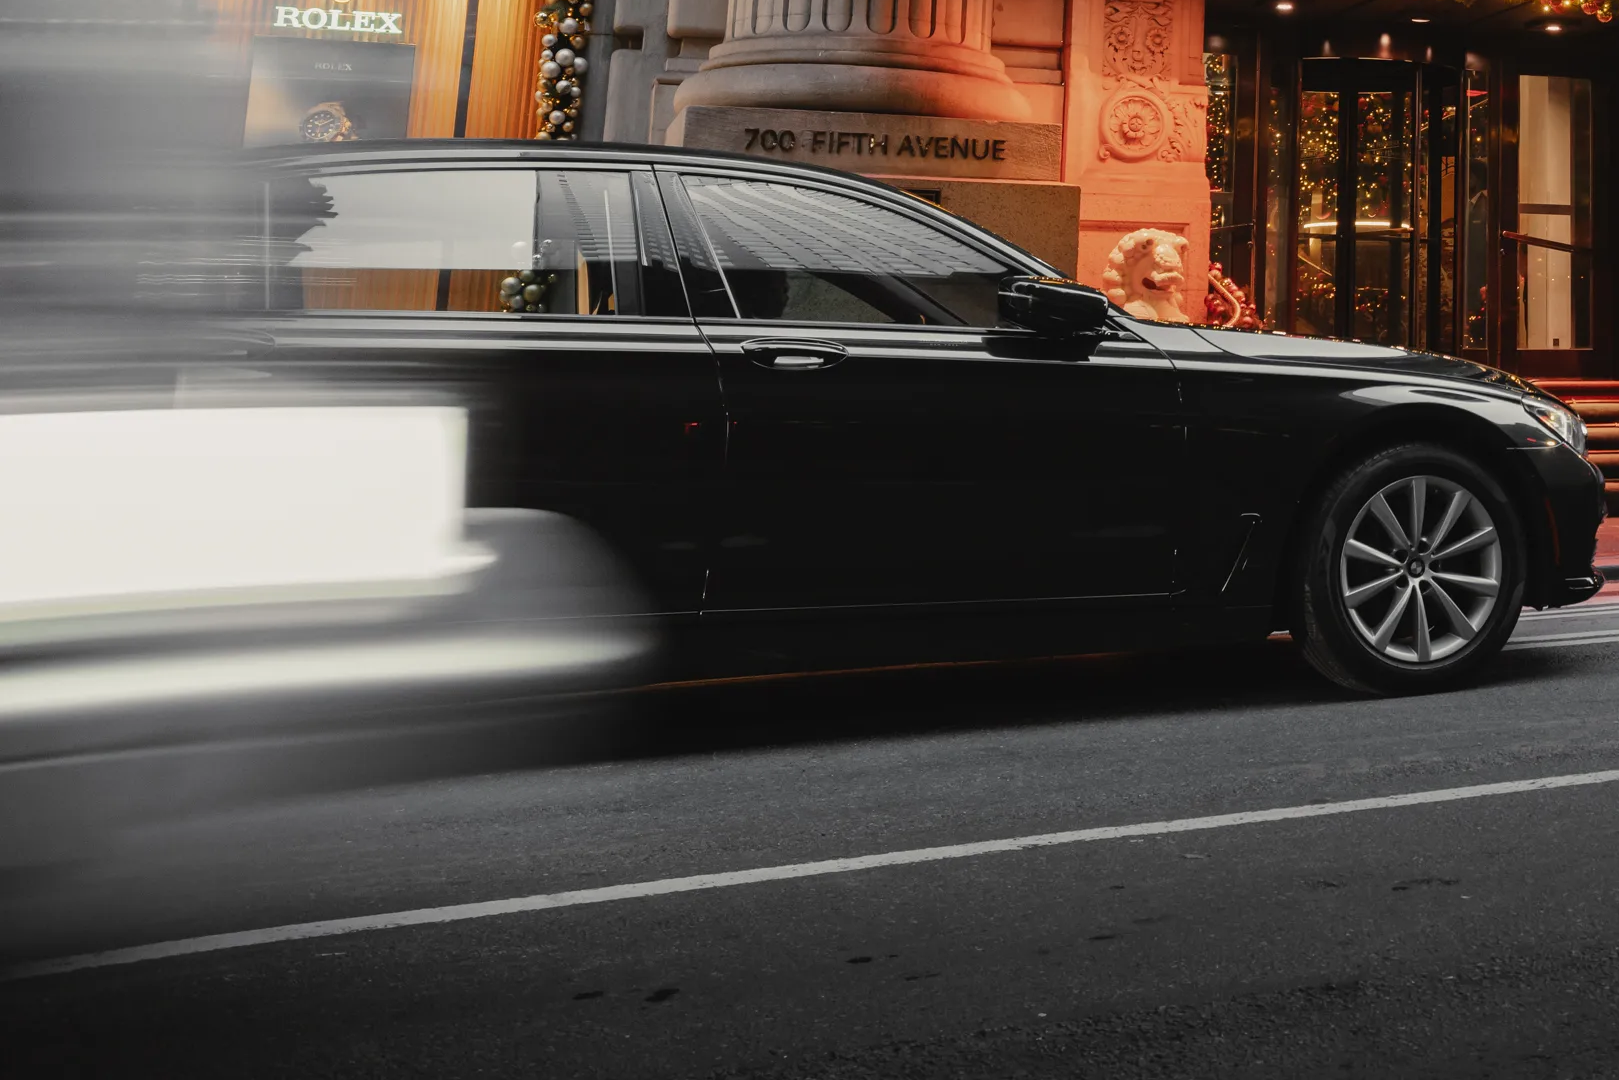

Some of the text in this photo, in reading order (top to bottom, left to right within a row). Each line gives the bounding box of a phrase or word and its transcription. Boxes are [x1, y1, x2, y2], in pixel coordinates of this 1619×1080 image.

[273, 5, 403, 34] ROLEX
[314, 62, 353, 71] ROLEX
[744, 128, 1008, 161] 700 FIFTH AVENUE
